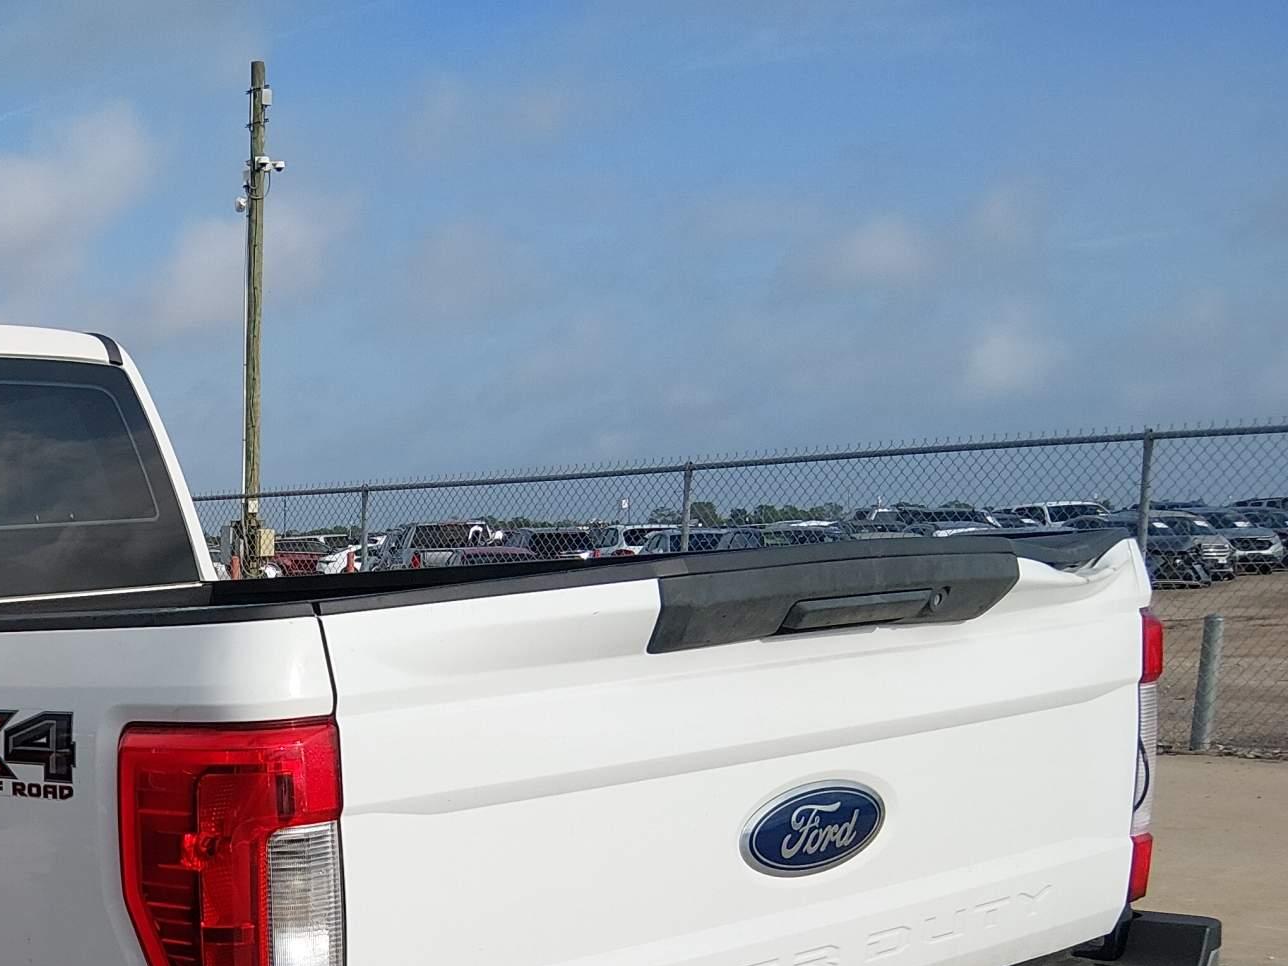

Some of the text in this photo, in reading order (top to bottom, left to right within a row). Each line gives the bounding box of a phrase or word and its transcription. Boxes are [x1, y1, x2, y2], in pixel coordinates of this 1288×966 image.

[12, 781, 74, 801] ROAD
[781, 801, 860, 859] Ford
[864, 883, 1054, 963] DUTY
